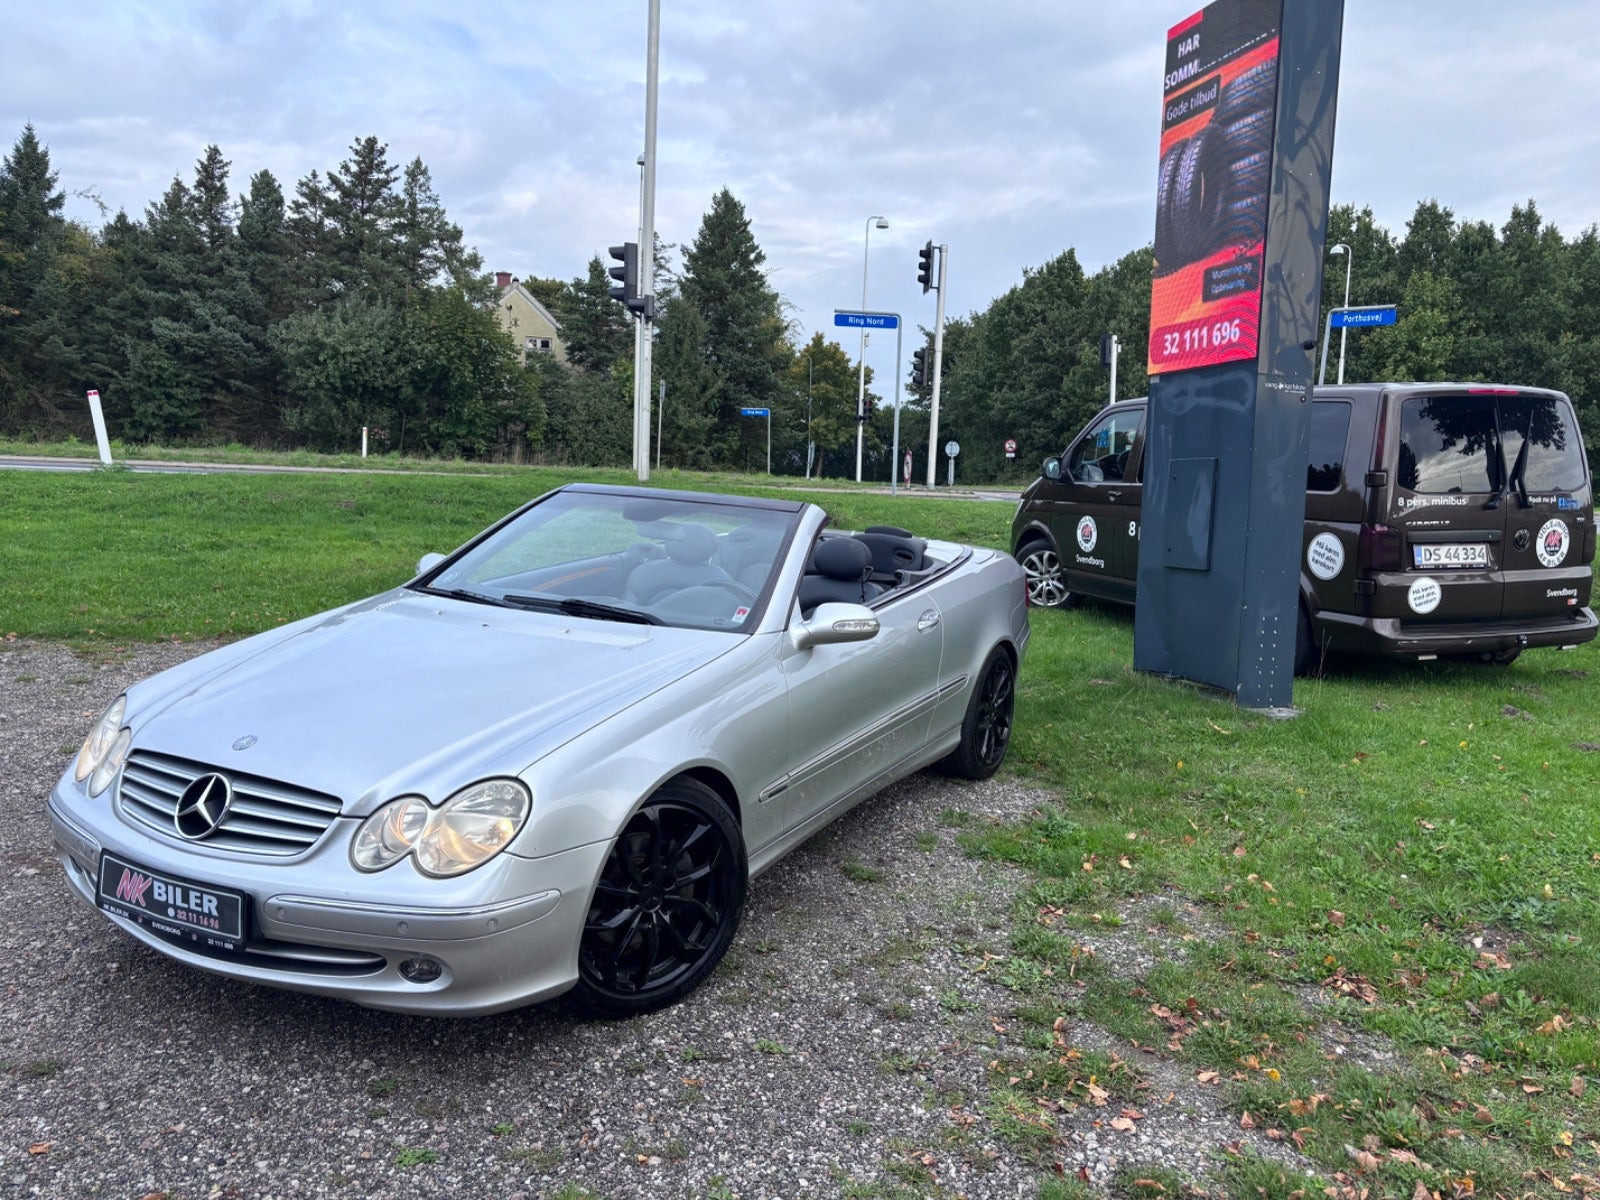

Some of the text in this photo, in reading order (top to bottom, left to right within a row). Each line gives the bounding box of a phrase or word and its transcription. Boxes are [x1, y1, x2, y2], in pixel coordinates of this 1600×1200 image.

[1177, 34, 1200, 58] HAR
[1164, 59, 1202, 90] SOMM
[1166, 84, 1217, 121] Gode tilbud
[848, 316, 884, 325] Ring Nord
[1163, 318, 1240, 355] 32 111 696
[1398, 496, 1467, 509] 8 pers. minibus
[1128, 521, 1136, 537] 8
[1076, 554, 1105, 569] Svendborg
[1424, 548, 1441, 562] DS
[1546, 588, 1577, 598] Svendborg
[116, 868, 219, 917] NK BILER
[177, 909, 220, 930] 32 11 16 96
